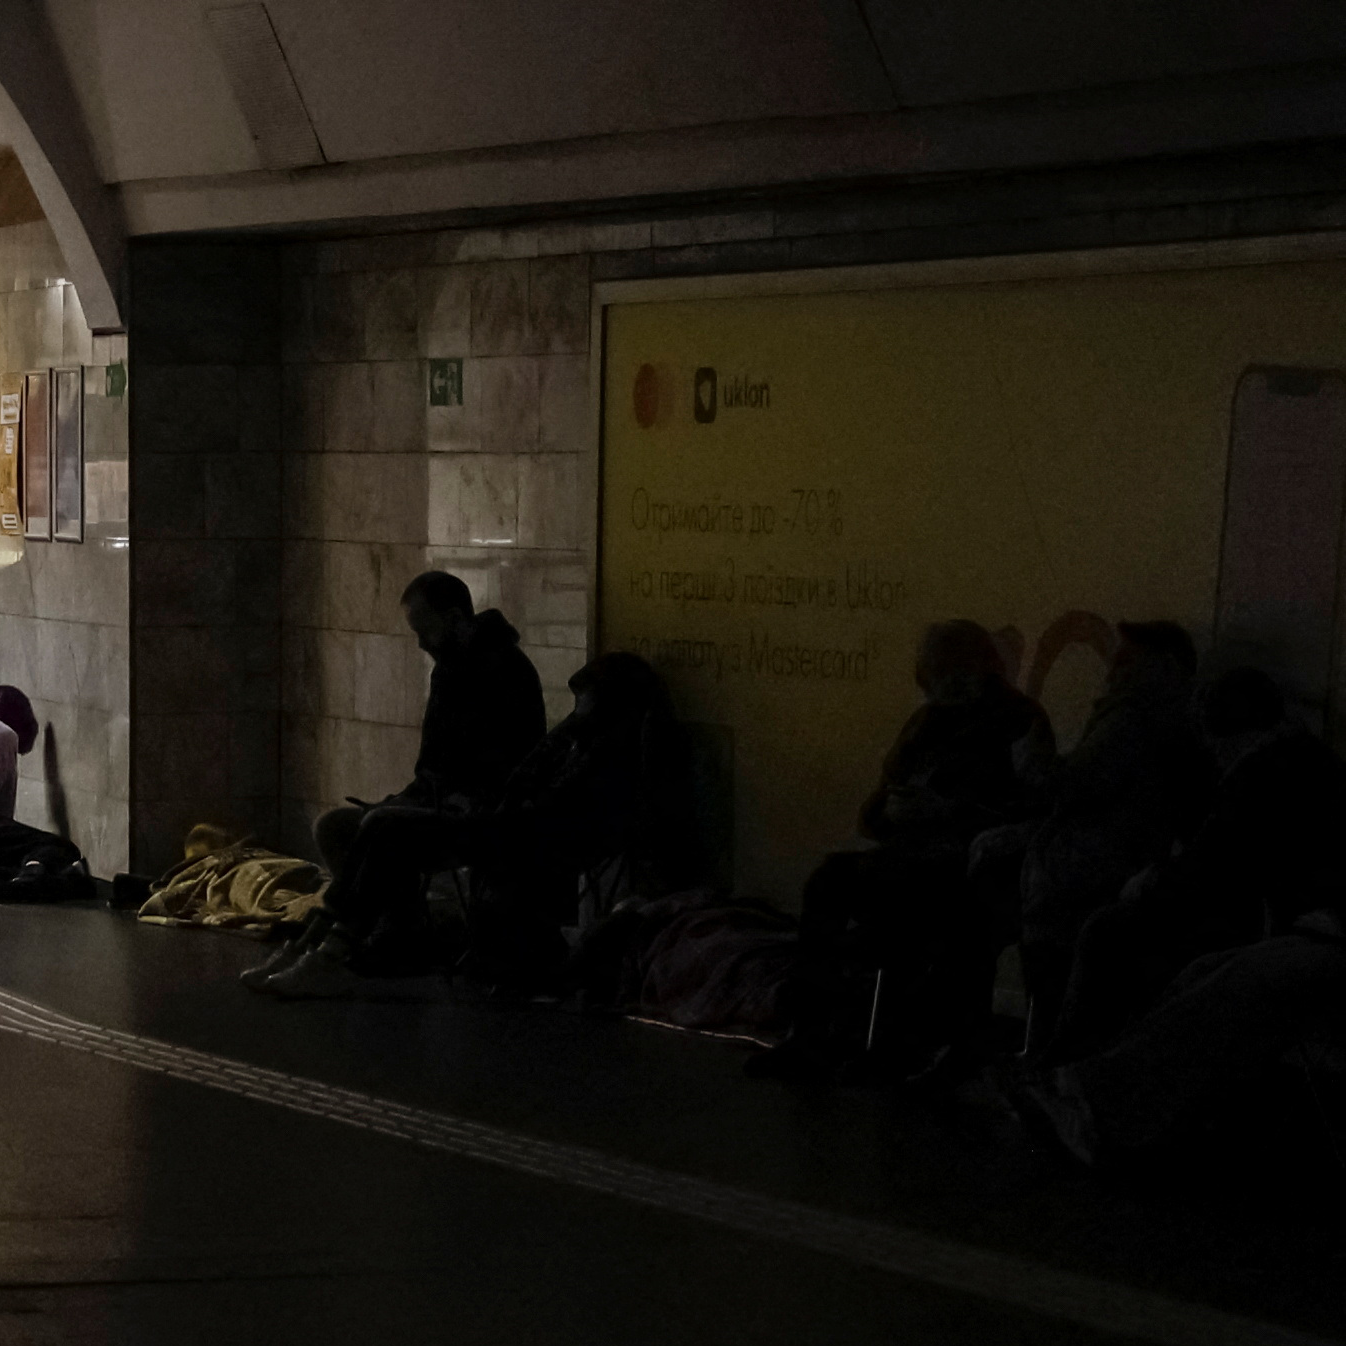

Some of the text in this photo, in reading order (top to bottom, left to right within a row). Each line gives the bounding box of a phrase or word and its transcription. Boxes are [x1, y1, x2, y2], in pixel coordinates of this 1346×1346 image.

[723, 375, 770, 408] uklon
[749, 504, 775, 536] до
[629, 571, 653, 598] на
[724, 557, 736, 602] 3
[845, 559, 907, 611] Uklon
